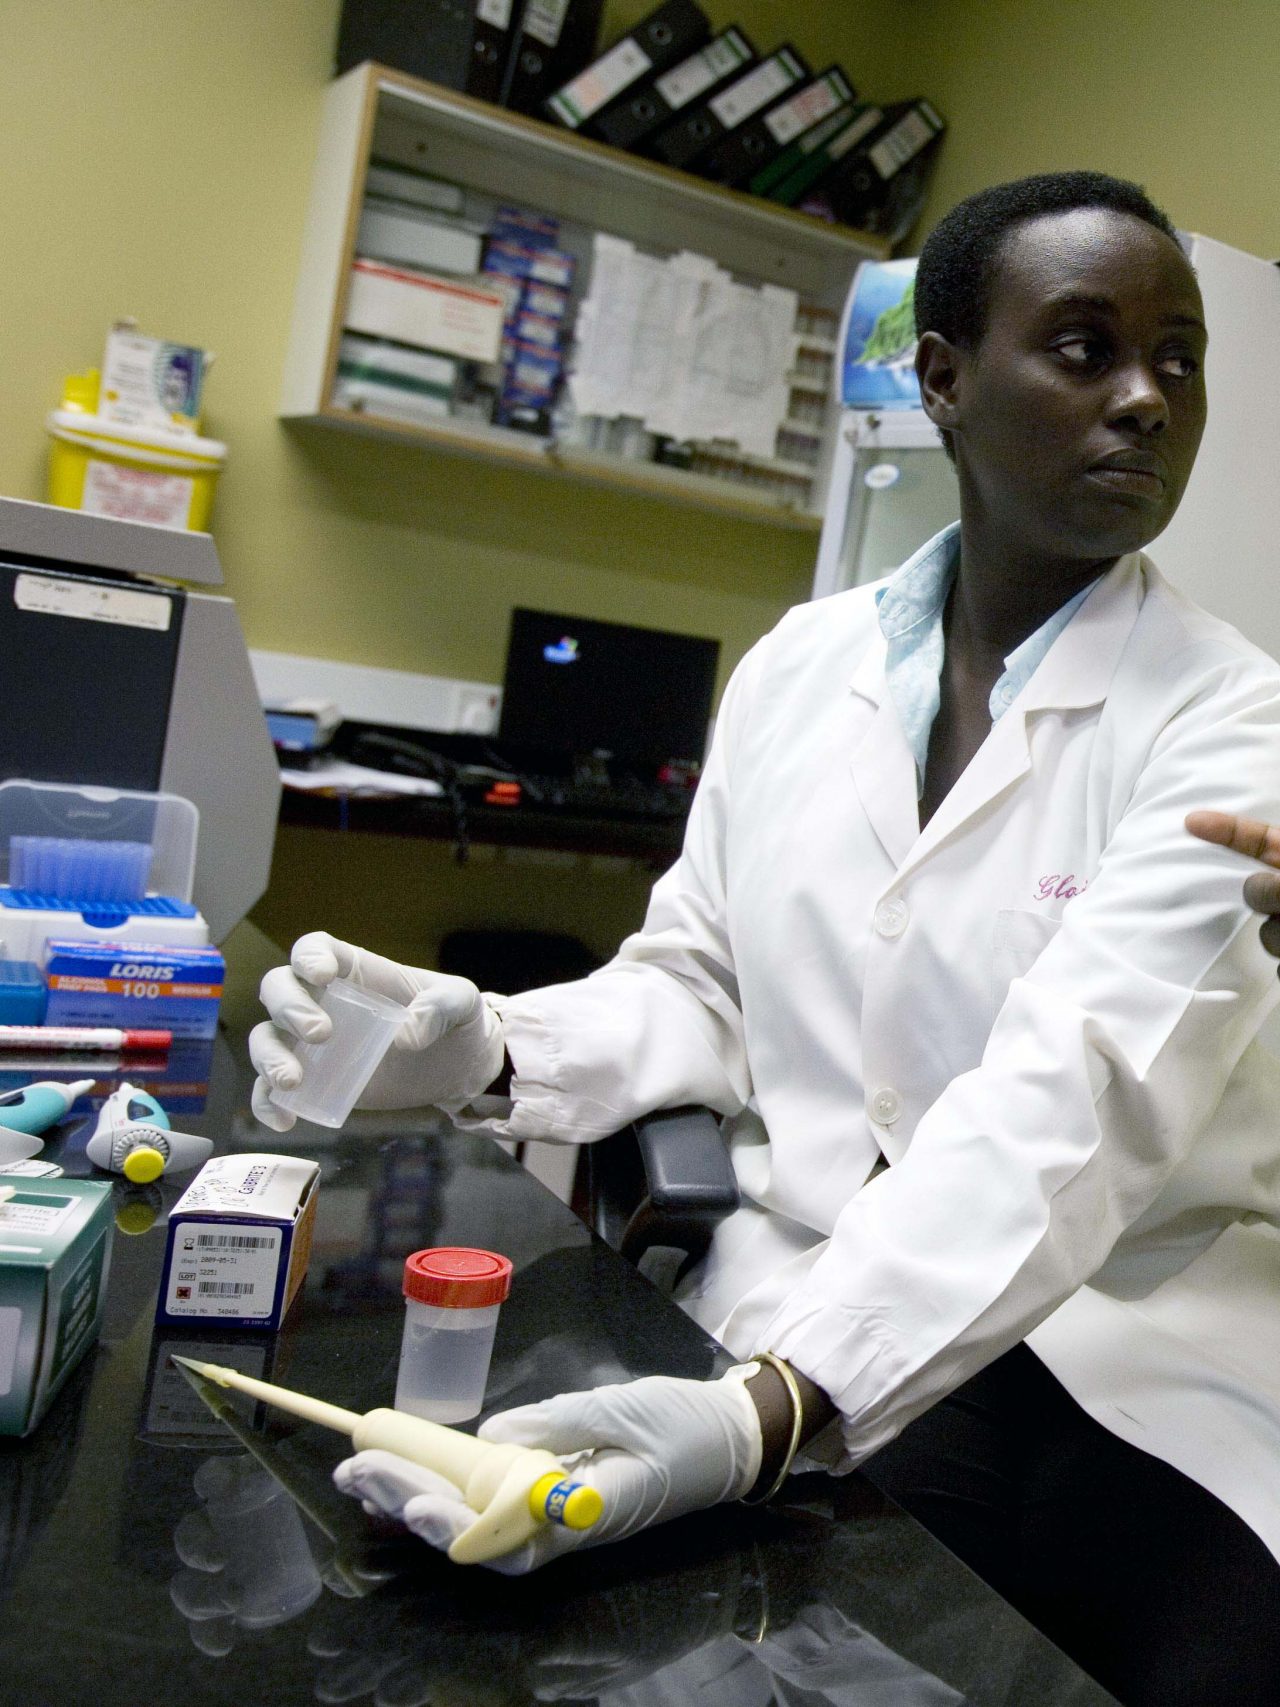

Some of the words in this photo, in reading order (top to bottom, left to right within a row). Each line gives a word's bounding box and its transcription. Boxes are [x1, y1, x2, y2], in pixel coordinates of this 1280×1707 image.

[110, 963, 174, 981] LORIS
[122, 983, 160, 999] 100
[170, 1307, 197, 1315] Catalog
